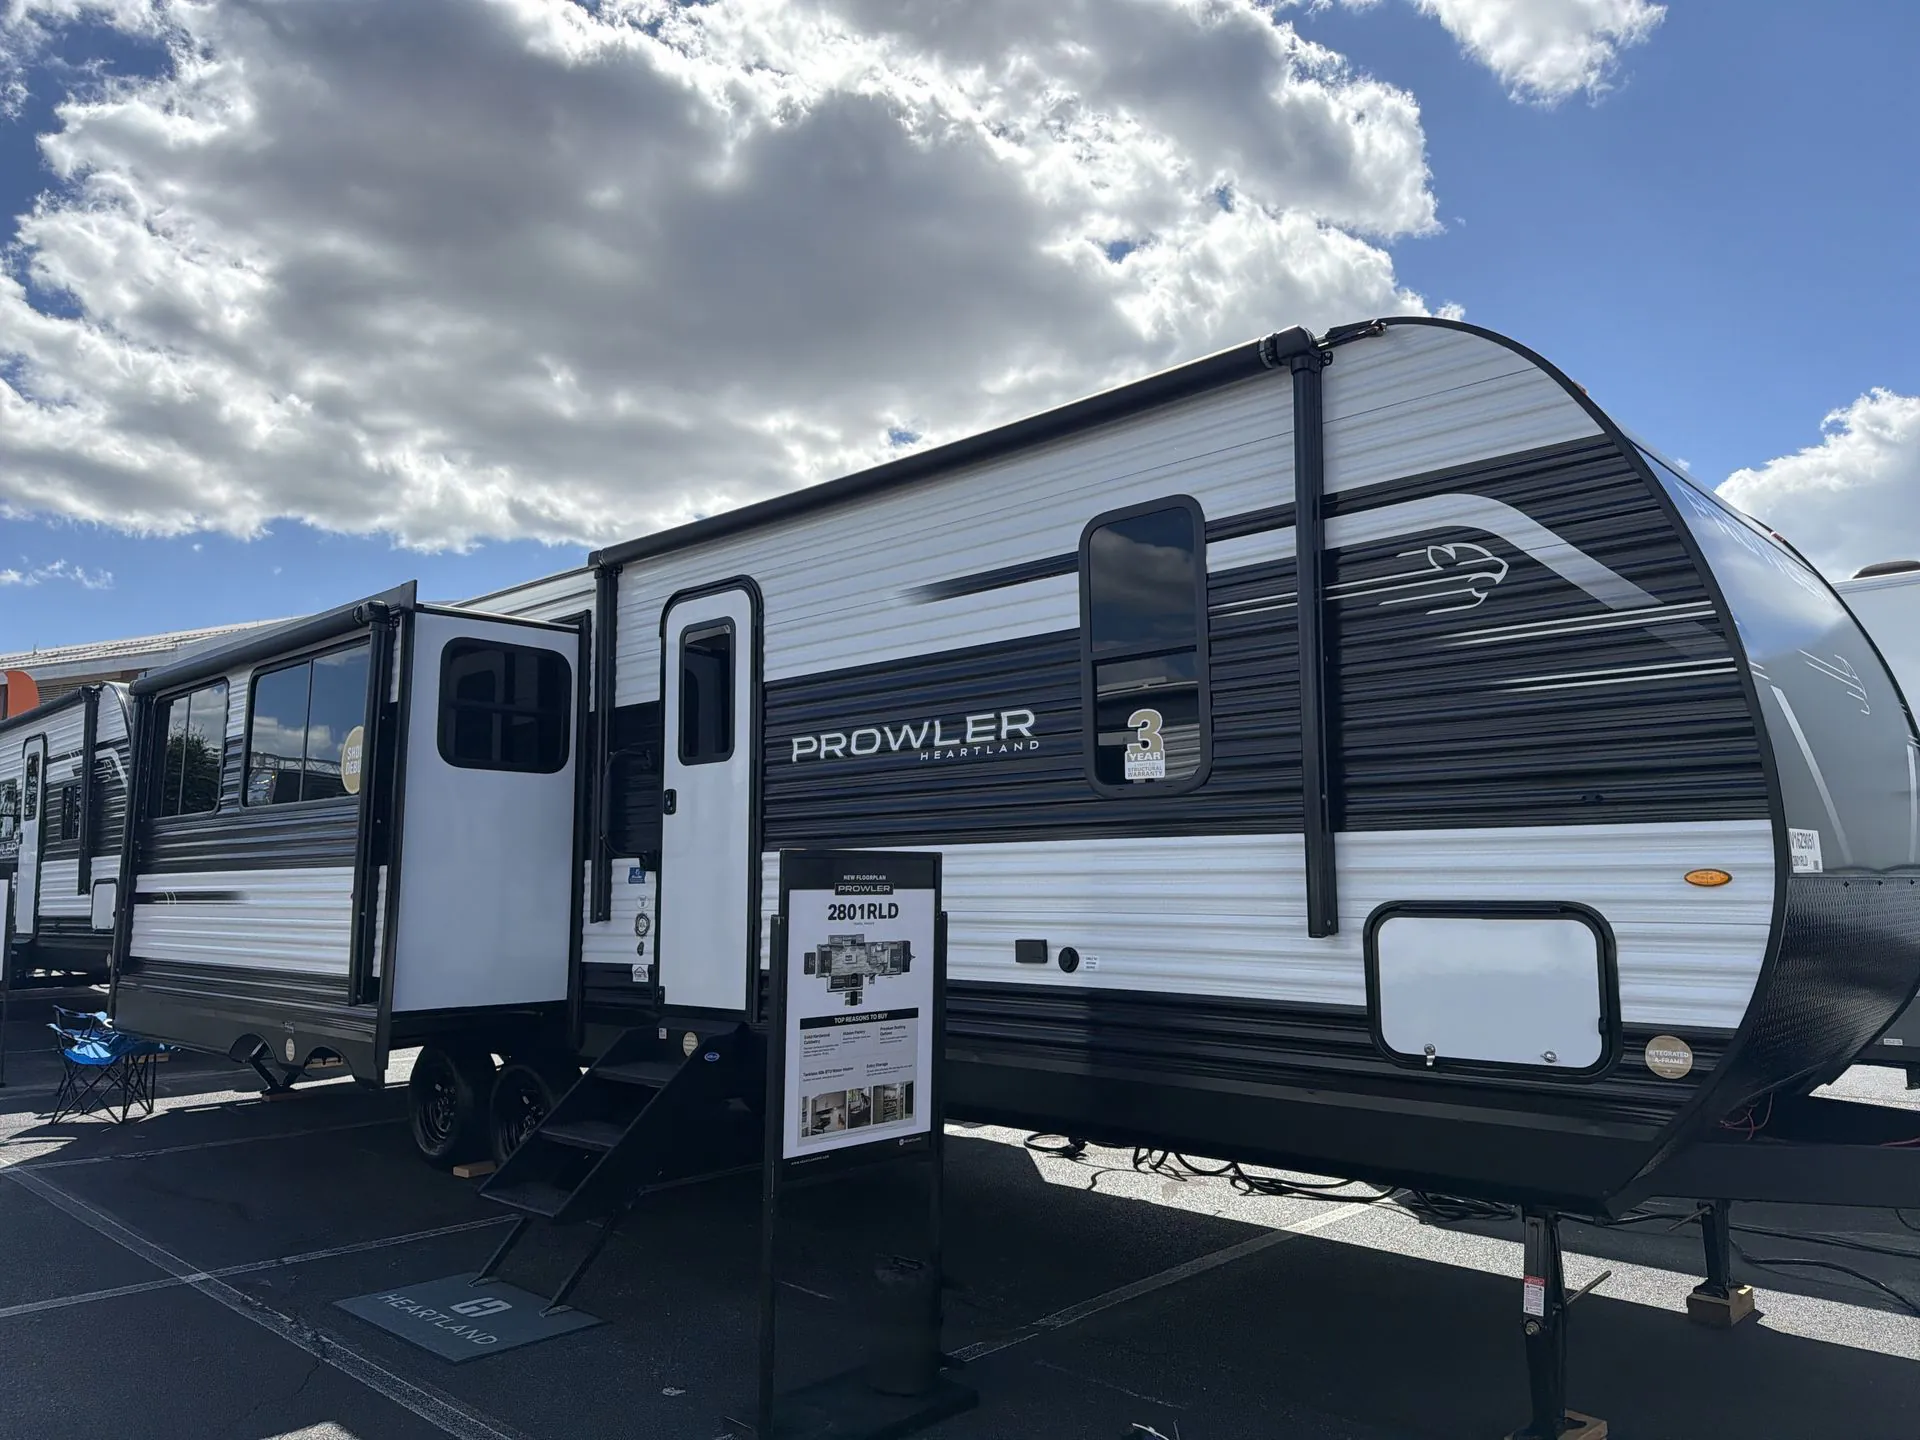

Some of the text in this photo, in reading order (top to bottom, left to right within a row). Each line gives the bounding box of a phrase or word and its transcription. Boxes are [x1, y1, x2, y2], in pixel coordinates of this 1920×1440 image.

[791, 709, 1036, 763] PROWLER
[1128, 708, 1164, 752] 3
[347, 745, 362, 760] SHO
[920, 741, 1040, 761] HEARTLAND
[1128, 752, 1161, 761] YEAR
[345, 760, 361, 775] DEBU
[838, 885, 891, 893] PROWLER
[828, 903, 899, 921] 2801RLD
[845, 1014, 870, 1022] REASONS
[877, 1012, 888, 1020] BUY
[1648, 1050, 1689, 1058] INTEGRATED
[376, 1293, 499, 1346] HEARTLAND
